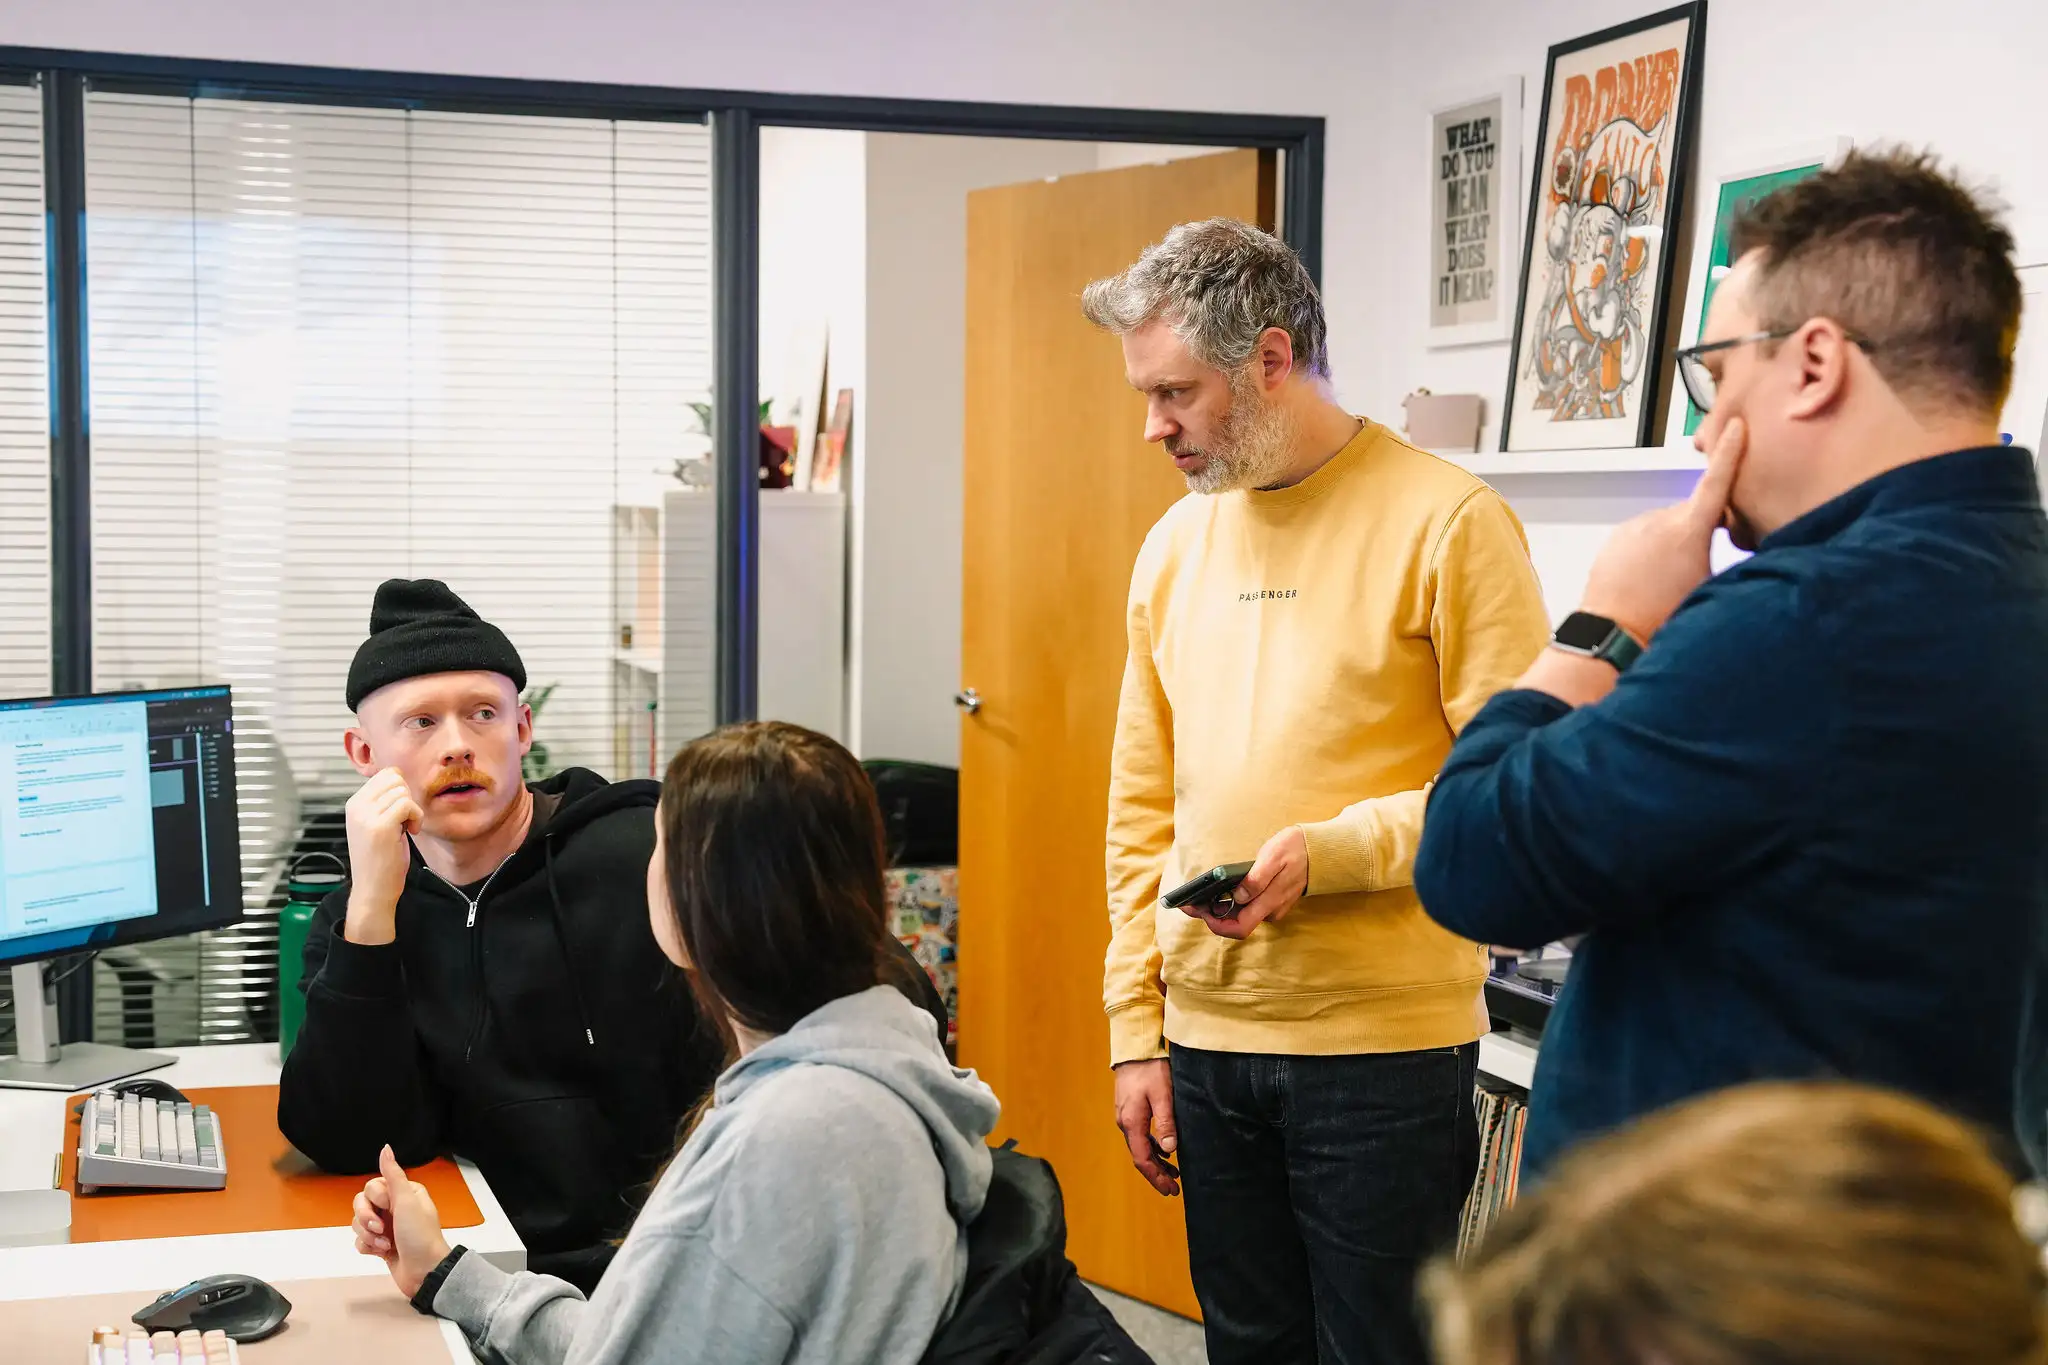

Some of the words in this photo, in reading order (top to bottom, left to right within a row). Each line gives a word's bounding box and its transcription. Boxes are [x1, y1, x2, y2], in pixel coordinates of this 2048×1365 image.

[1446, 117, 1491, 151] WHAT
[1441, 152, 1460, 180] DO
[1464, 143, 1494, 173] YOU
[1447, 175, 1488, 218] MEAN
[1445, 214, 1490, 245] WHAT
[1448, 242, 1485, 272] DOES
[1440, 276, 1450, 306] IT
[1453, 268, 1493, 303] MEAN?
[1239, 589, 1297, 602] PASSENGER
